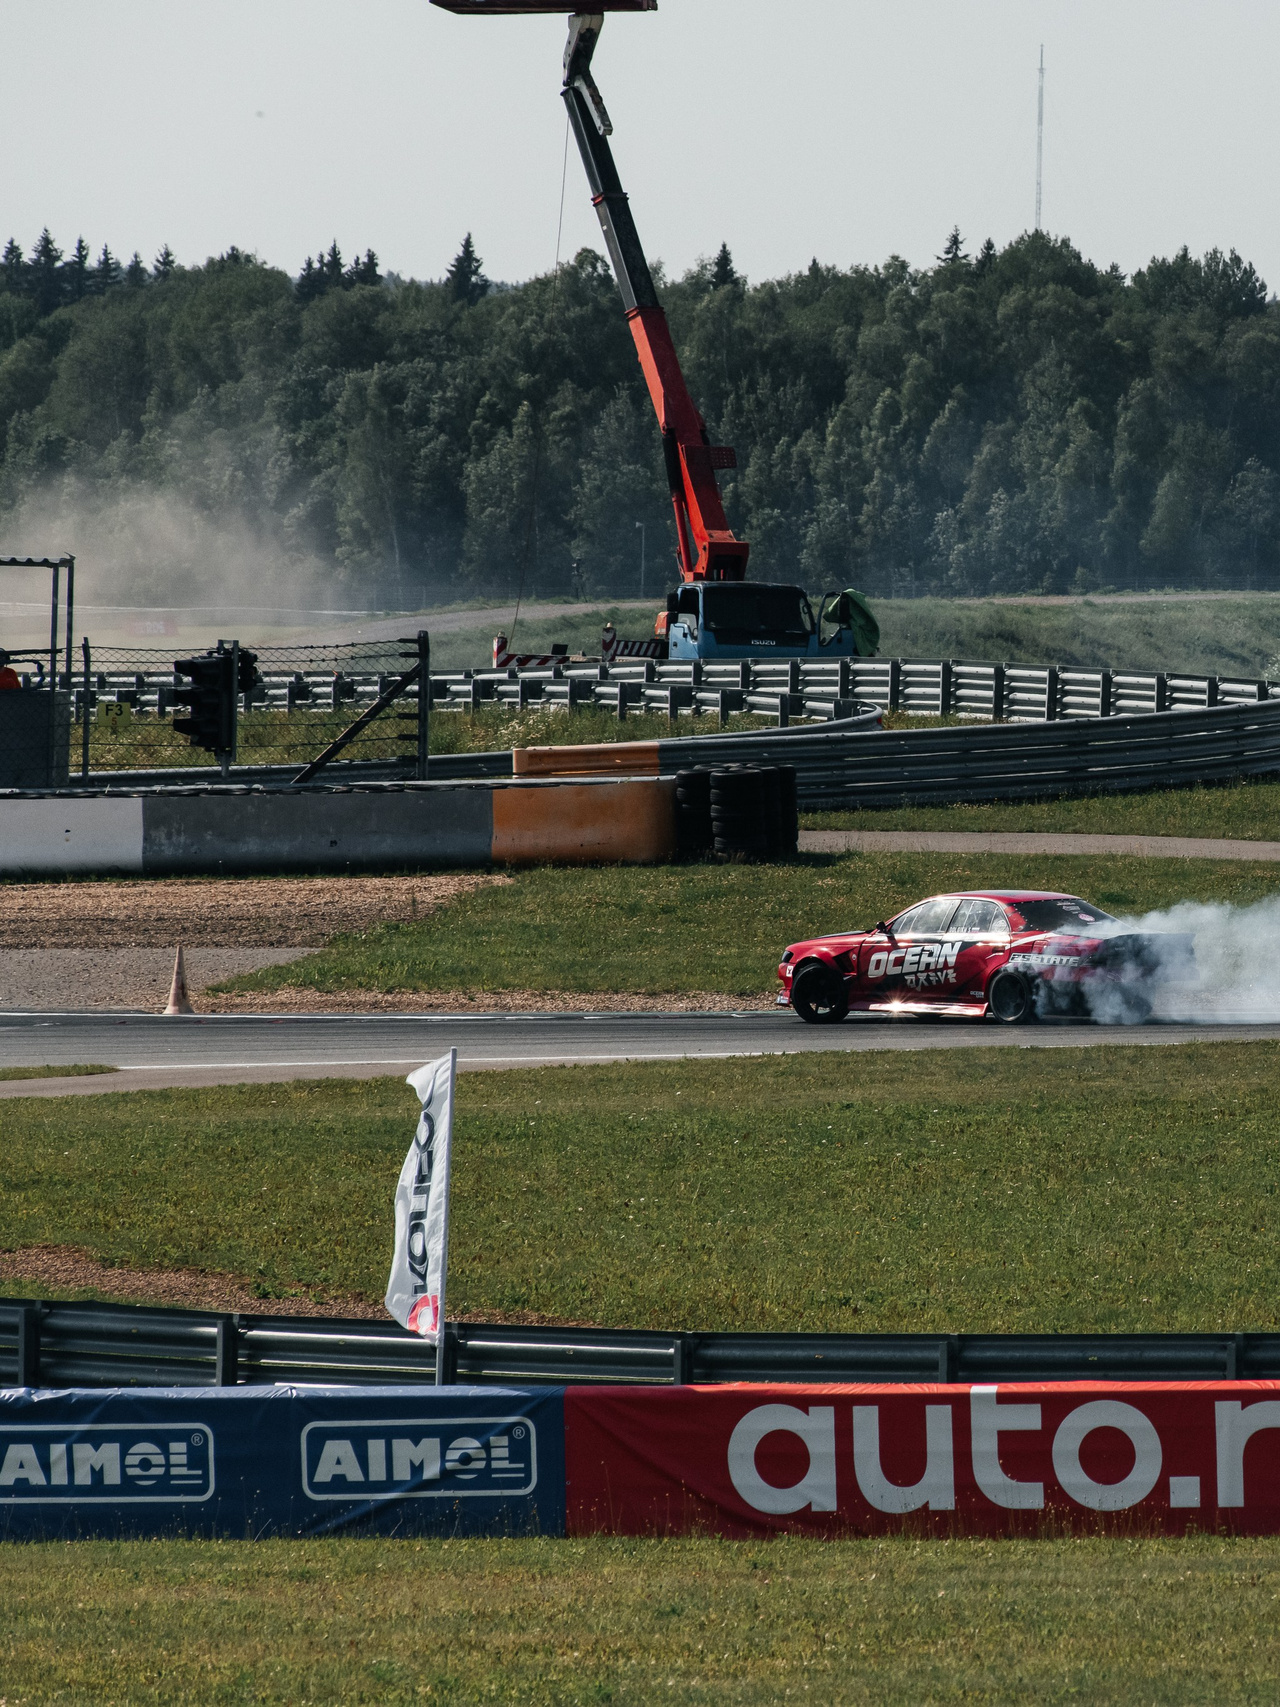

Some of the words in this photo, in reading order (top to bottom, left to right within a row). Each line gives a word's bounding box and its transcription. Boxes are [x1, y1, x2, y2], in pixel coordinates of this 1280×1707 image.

[105, 703, 124, 717] F3
[111, 716, 118, 726] 5
[867, 941, 962, 979] OCEAN
[0, 1442, 203, 1486] AIMOL
[313, 1436, 525, 1483] AIMOL
